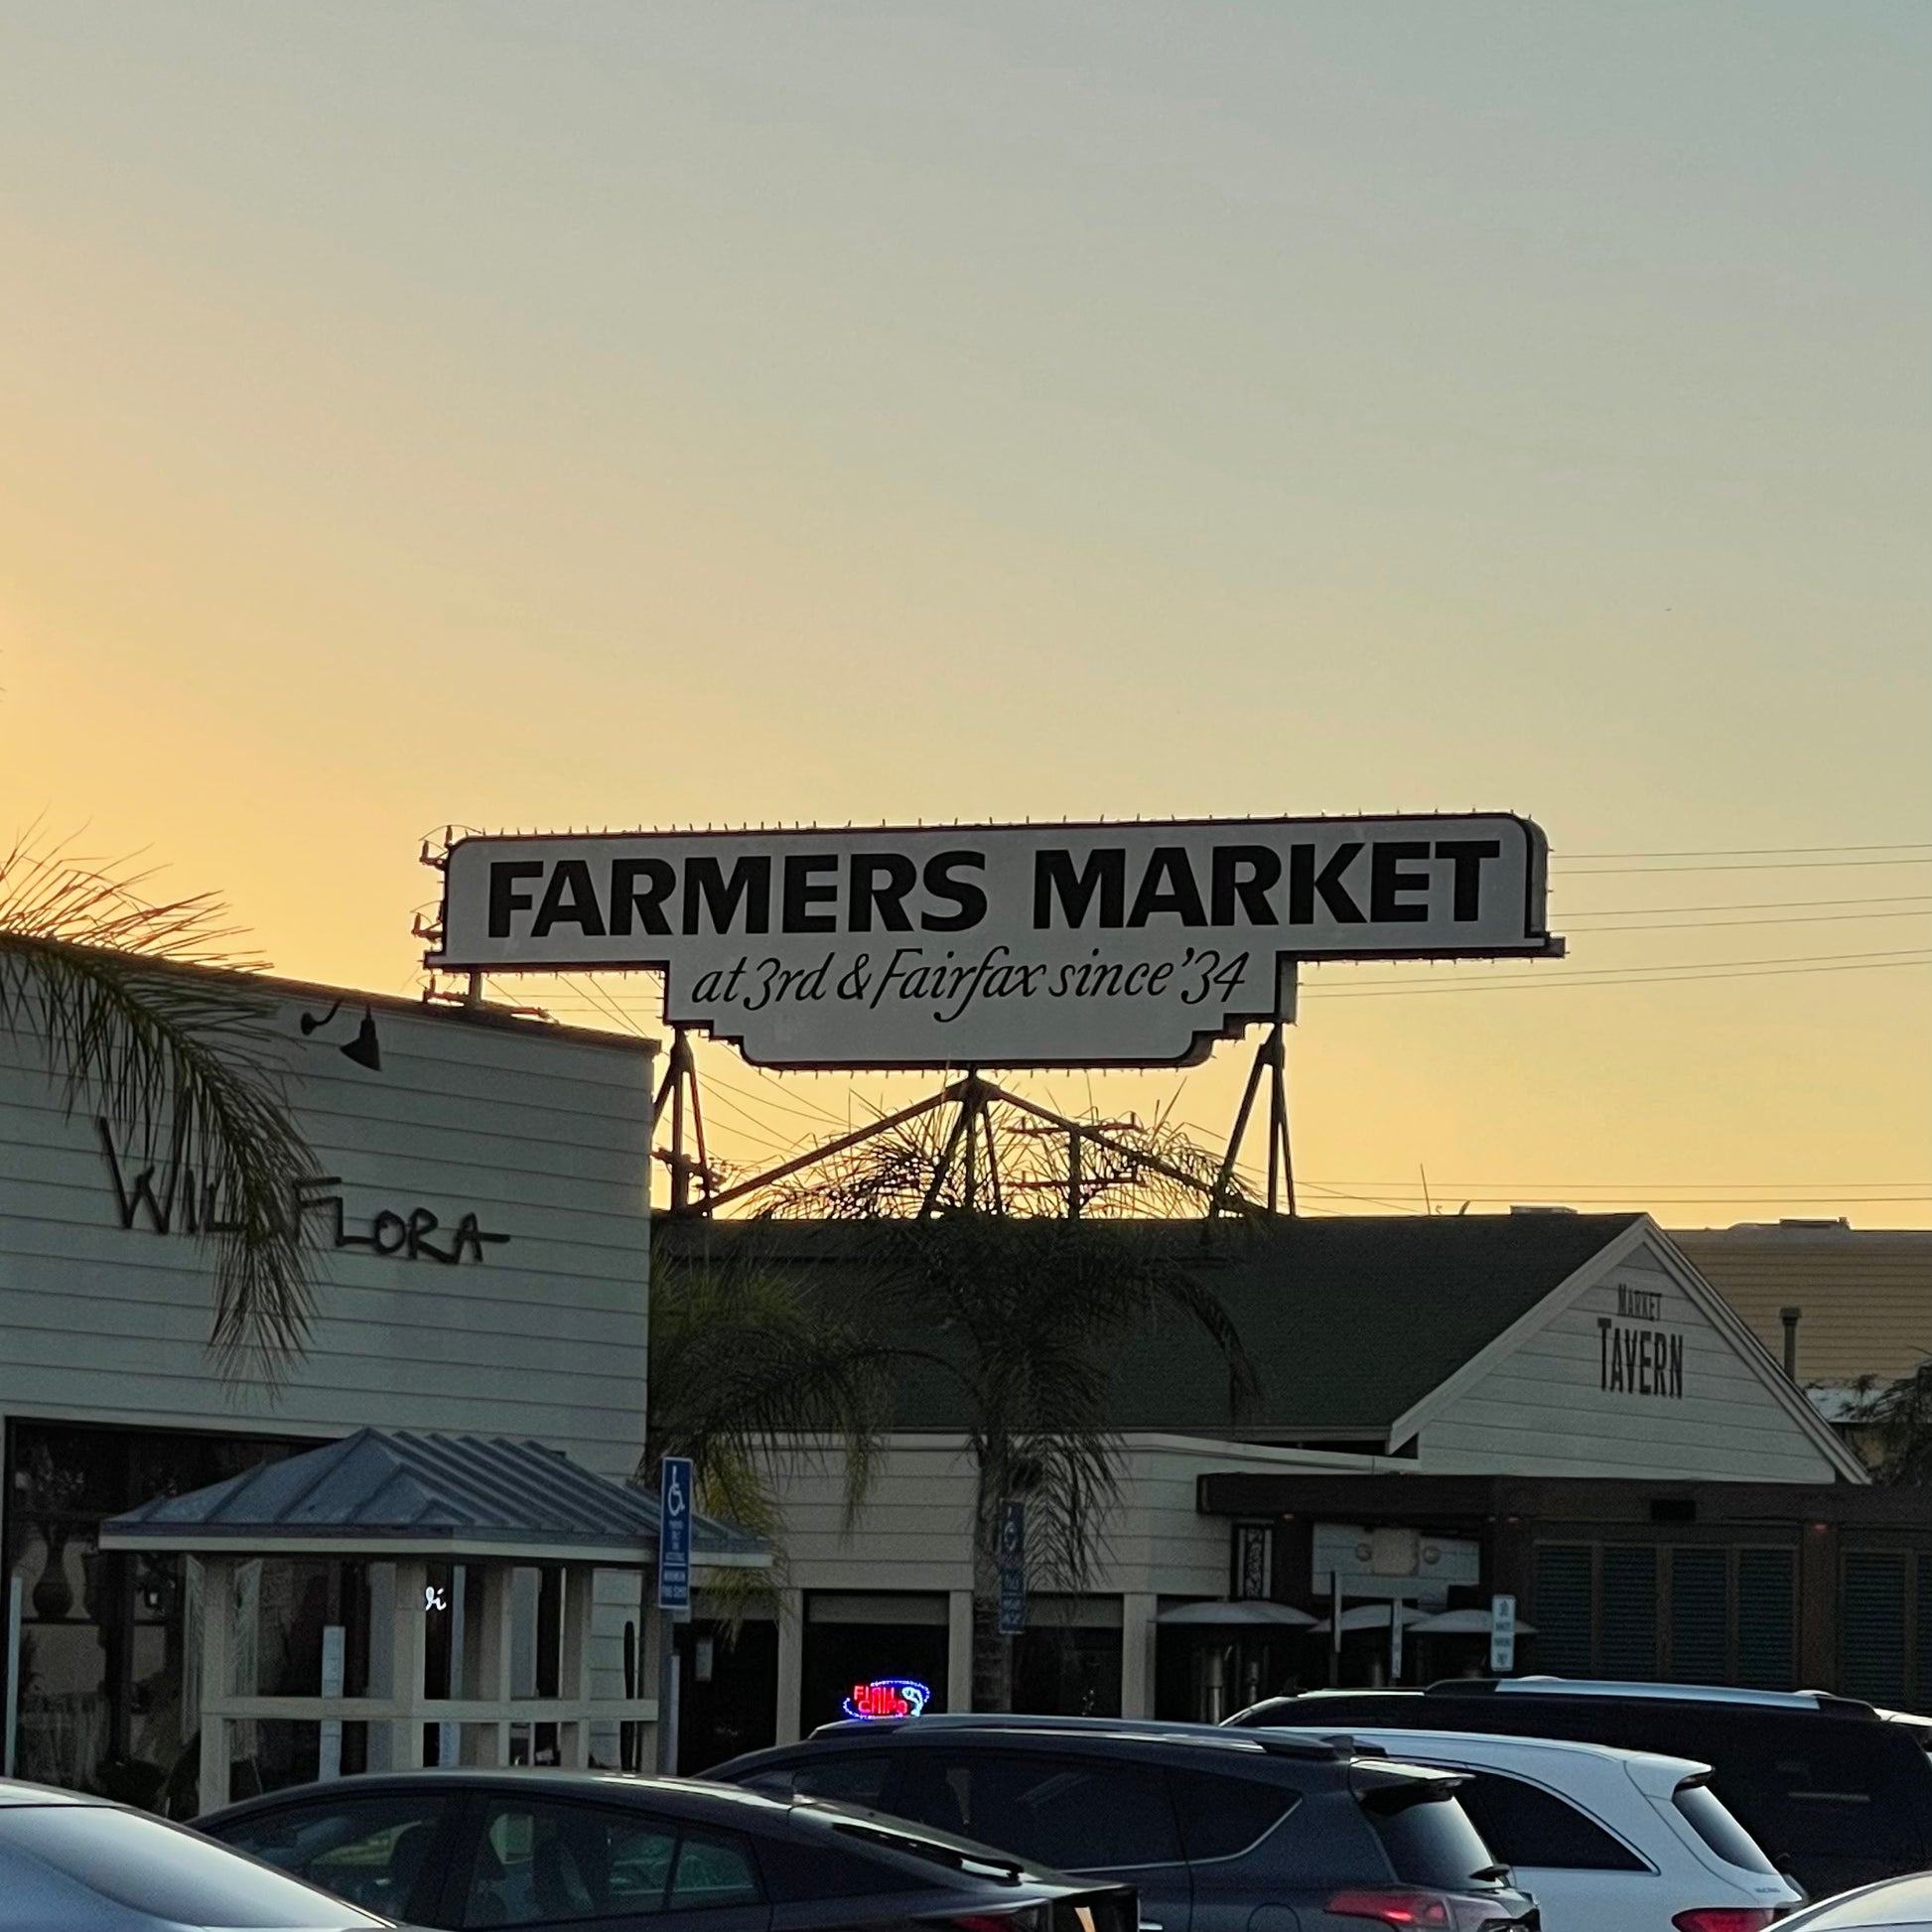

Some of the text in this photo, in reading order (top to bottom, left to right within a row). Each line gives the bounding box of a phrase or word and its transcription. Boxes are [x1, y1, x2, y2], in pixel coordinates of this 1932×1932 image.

[487, 840, 1501, 938] FARMERS MARKET
[692, 956, 748, 1004] at
[743, 951, 836, 1011] 3rd
[837, 953, 872, 1001] &
[869, 945, 1047, 1023] Fairfax
[1048, 947, 1174, 998] since
[99, 1114, 282, 1245] WIL
[1617, 1284, 1662, 1321] MARKET
[1596, 1316, 1684, 1400] TAVERN
